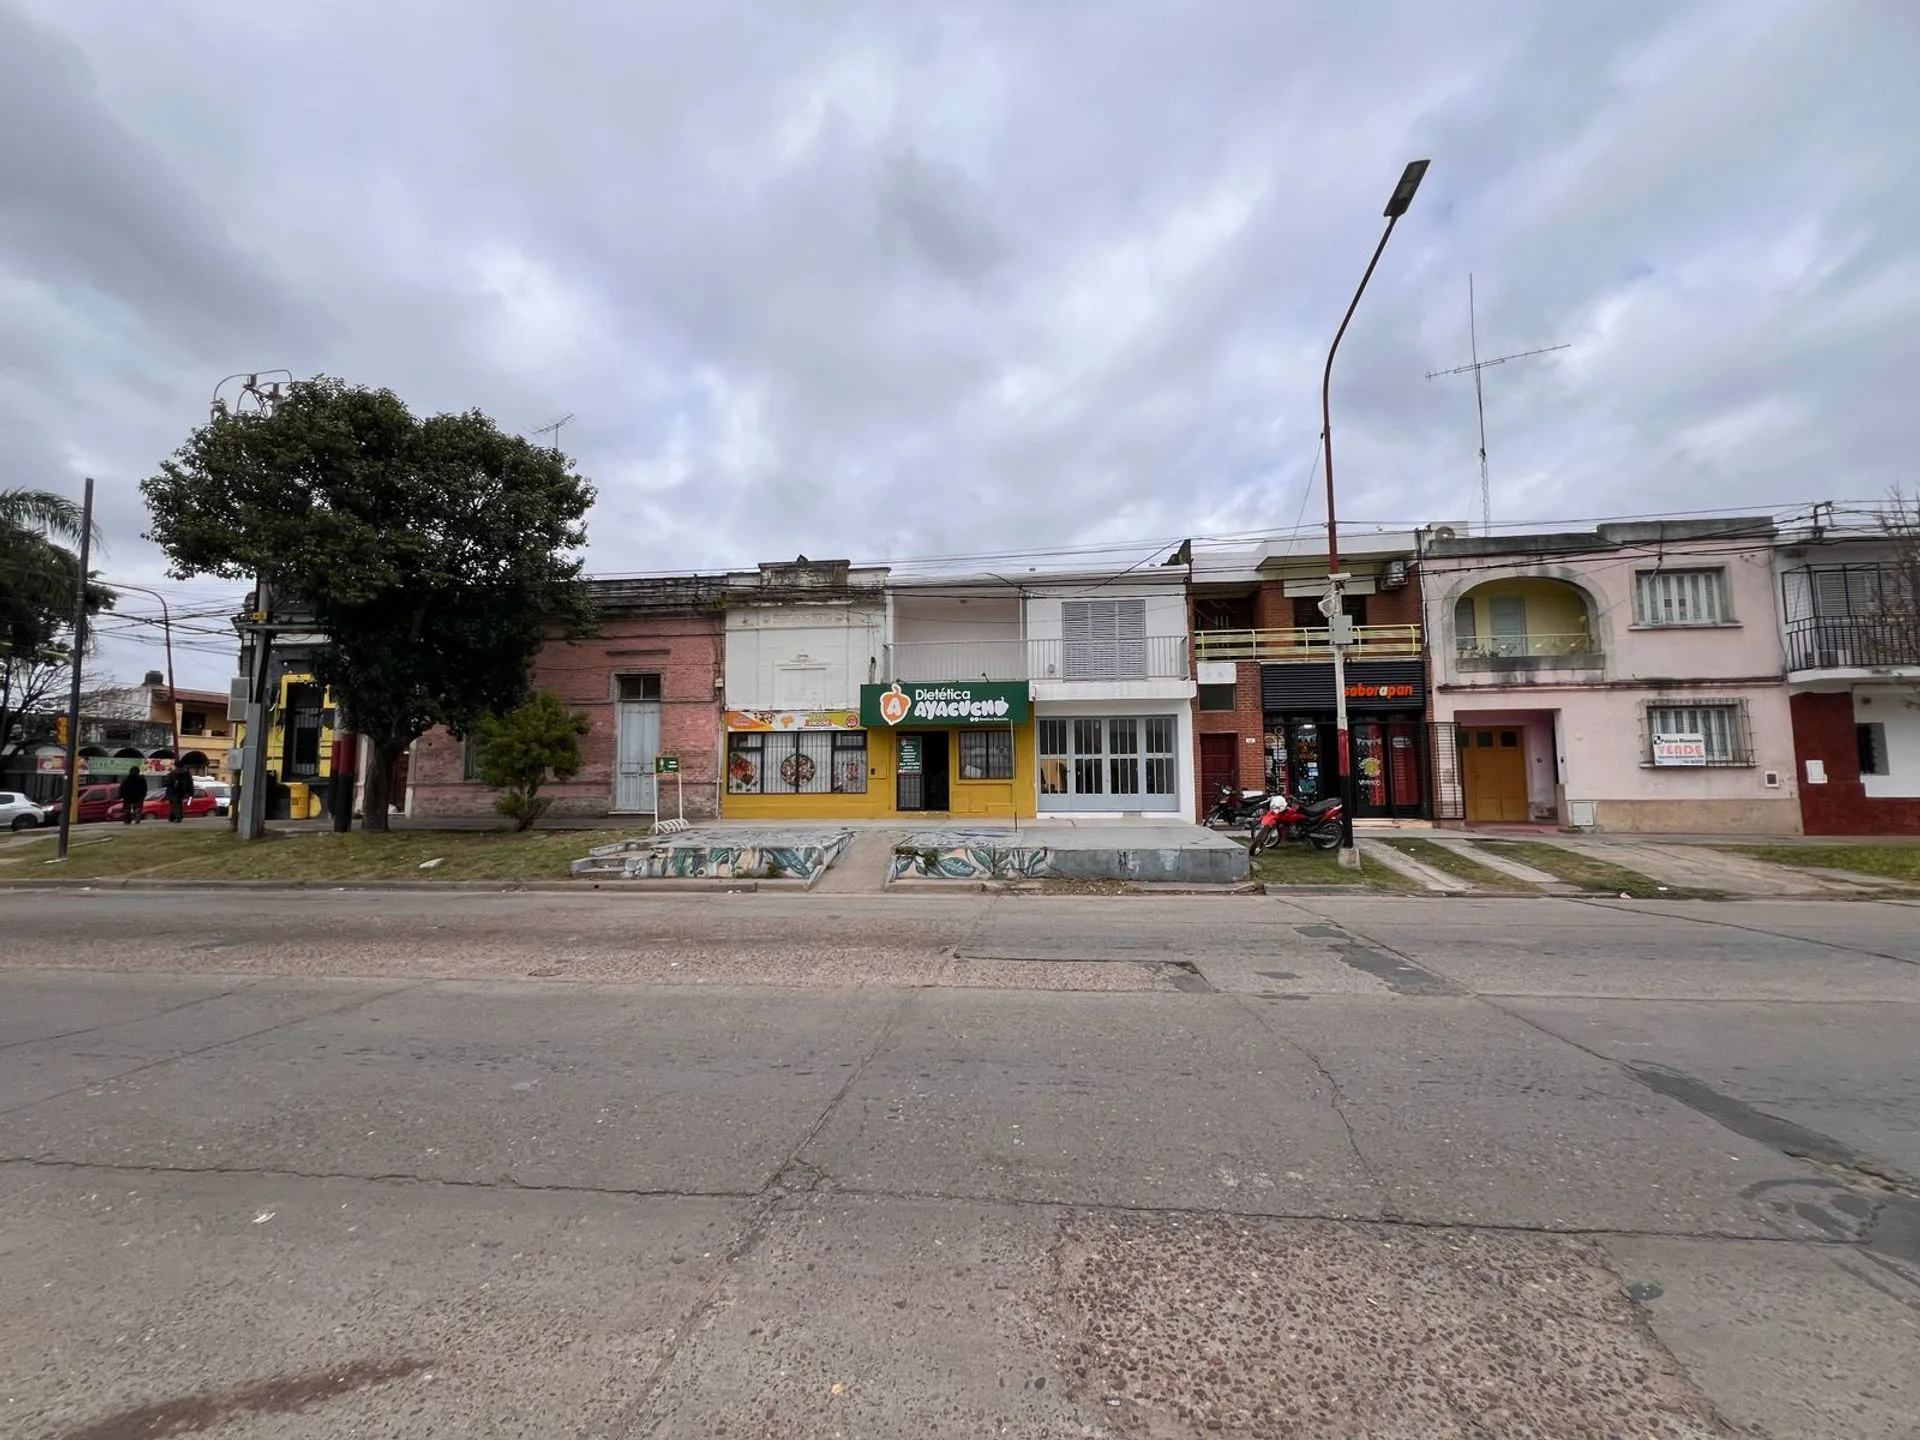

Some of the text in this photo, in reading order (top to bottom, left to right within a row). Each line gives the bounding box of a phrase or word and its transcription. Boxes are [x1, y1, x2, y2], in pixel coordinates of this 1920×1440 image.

[915, 687, 971, 700] Dietética
[887, 698, 901, 716] A
[914, 697, 1009, 720] AYACUCHO
